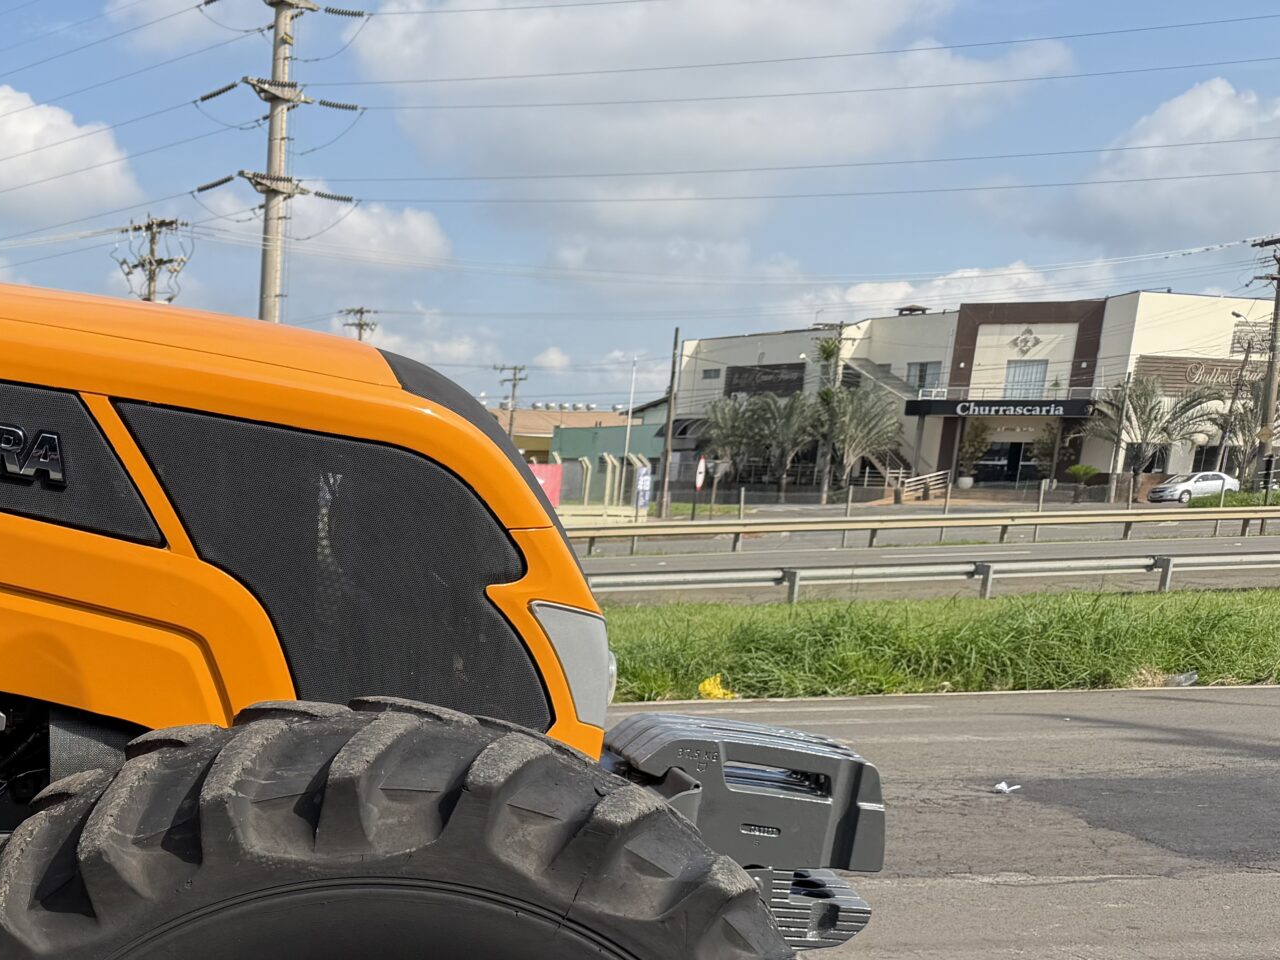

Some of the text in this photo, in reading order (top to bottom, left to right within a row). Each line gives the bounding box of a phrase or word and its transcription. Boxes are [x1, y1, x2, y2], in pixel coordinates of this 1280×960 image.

[1186, 362, 1230, 385] Buffet
[956, 401, 1065, 417] Churrascaria
[703, 752, 719, 762] KG
